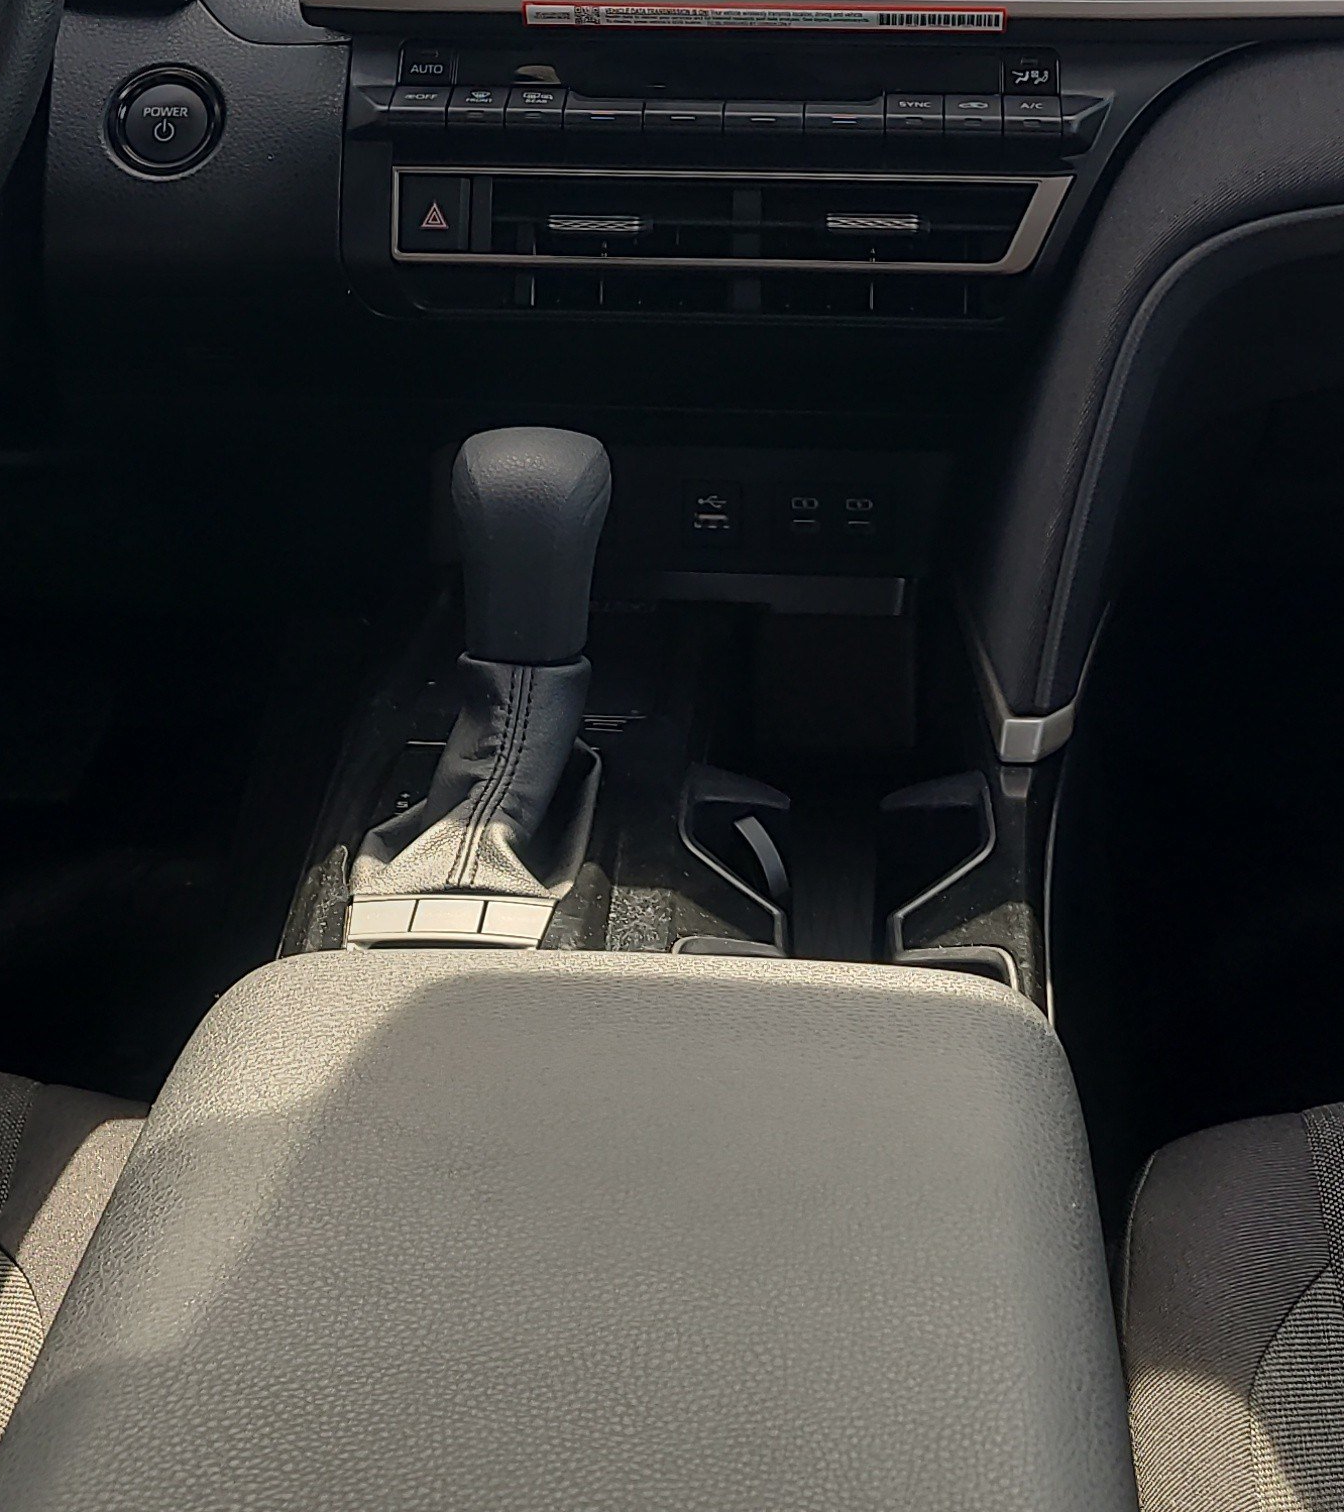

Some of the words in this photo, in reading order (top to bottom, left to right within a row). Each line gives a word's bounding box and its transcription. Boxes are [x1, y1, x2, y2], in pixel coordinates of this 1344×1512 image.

[410, 64, 444, 74] AUTO
[898, 101, 932, 109] SYNC
[1019, 102, 1045, 110] A/C
[142, 106, 189, 118] POWER
